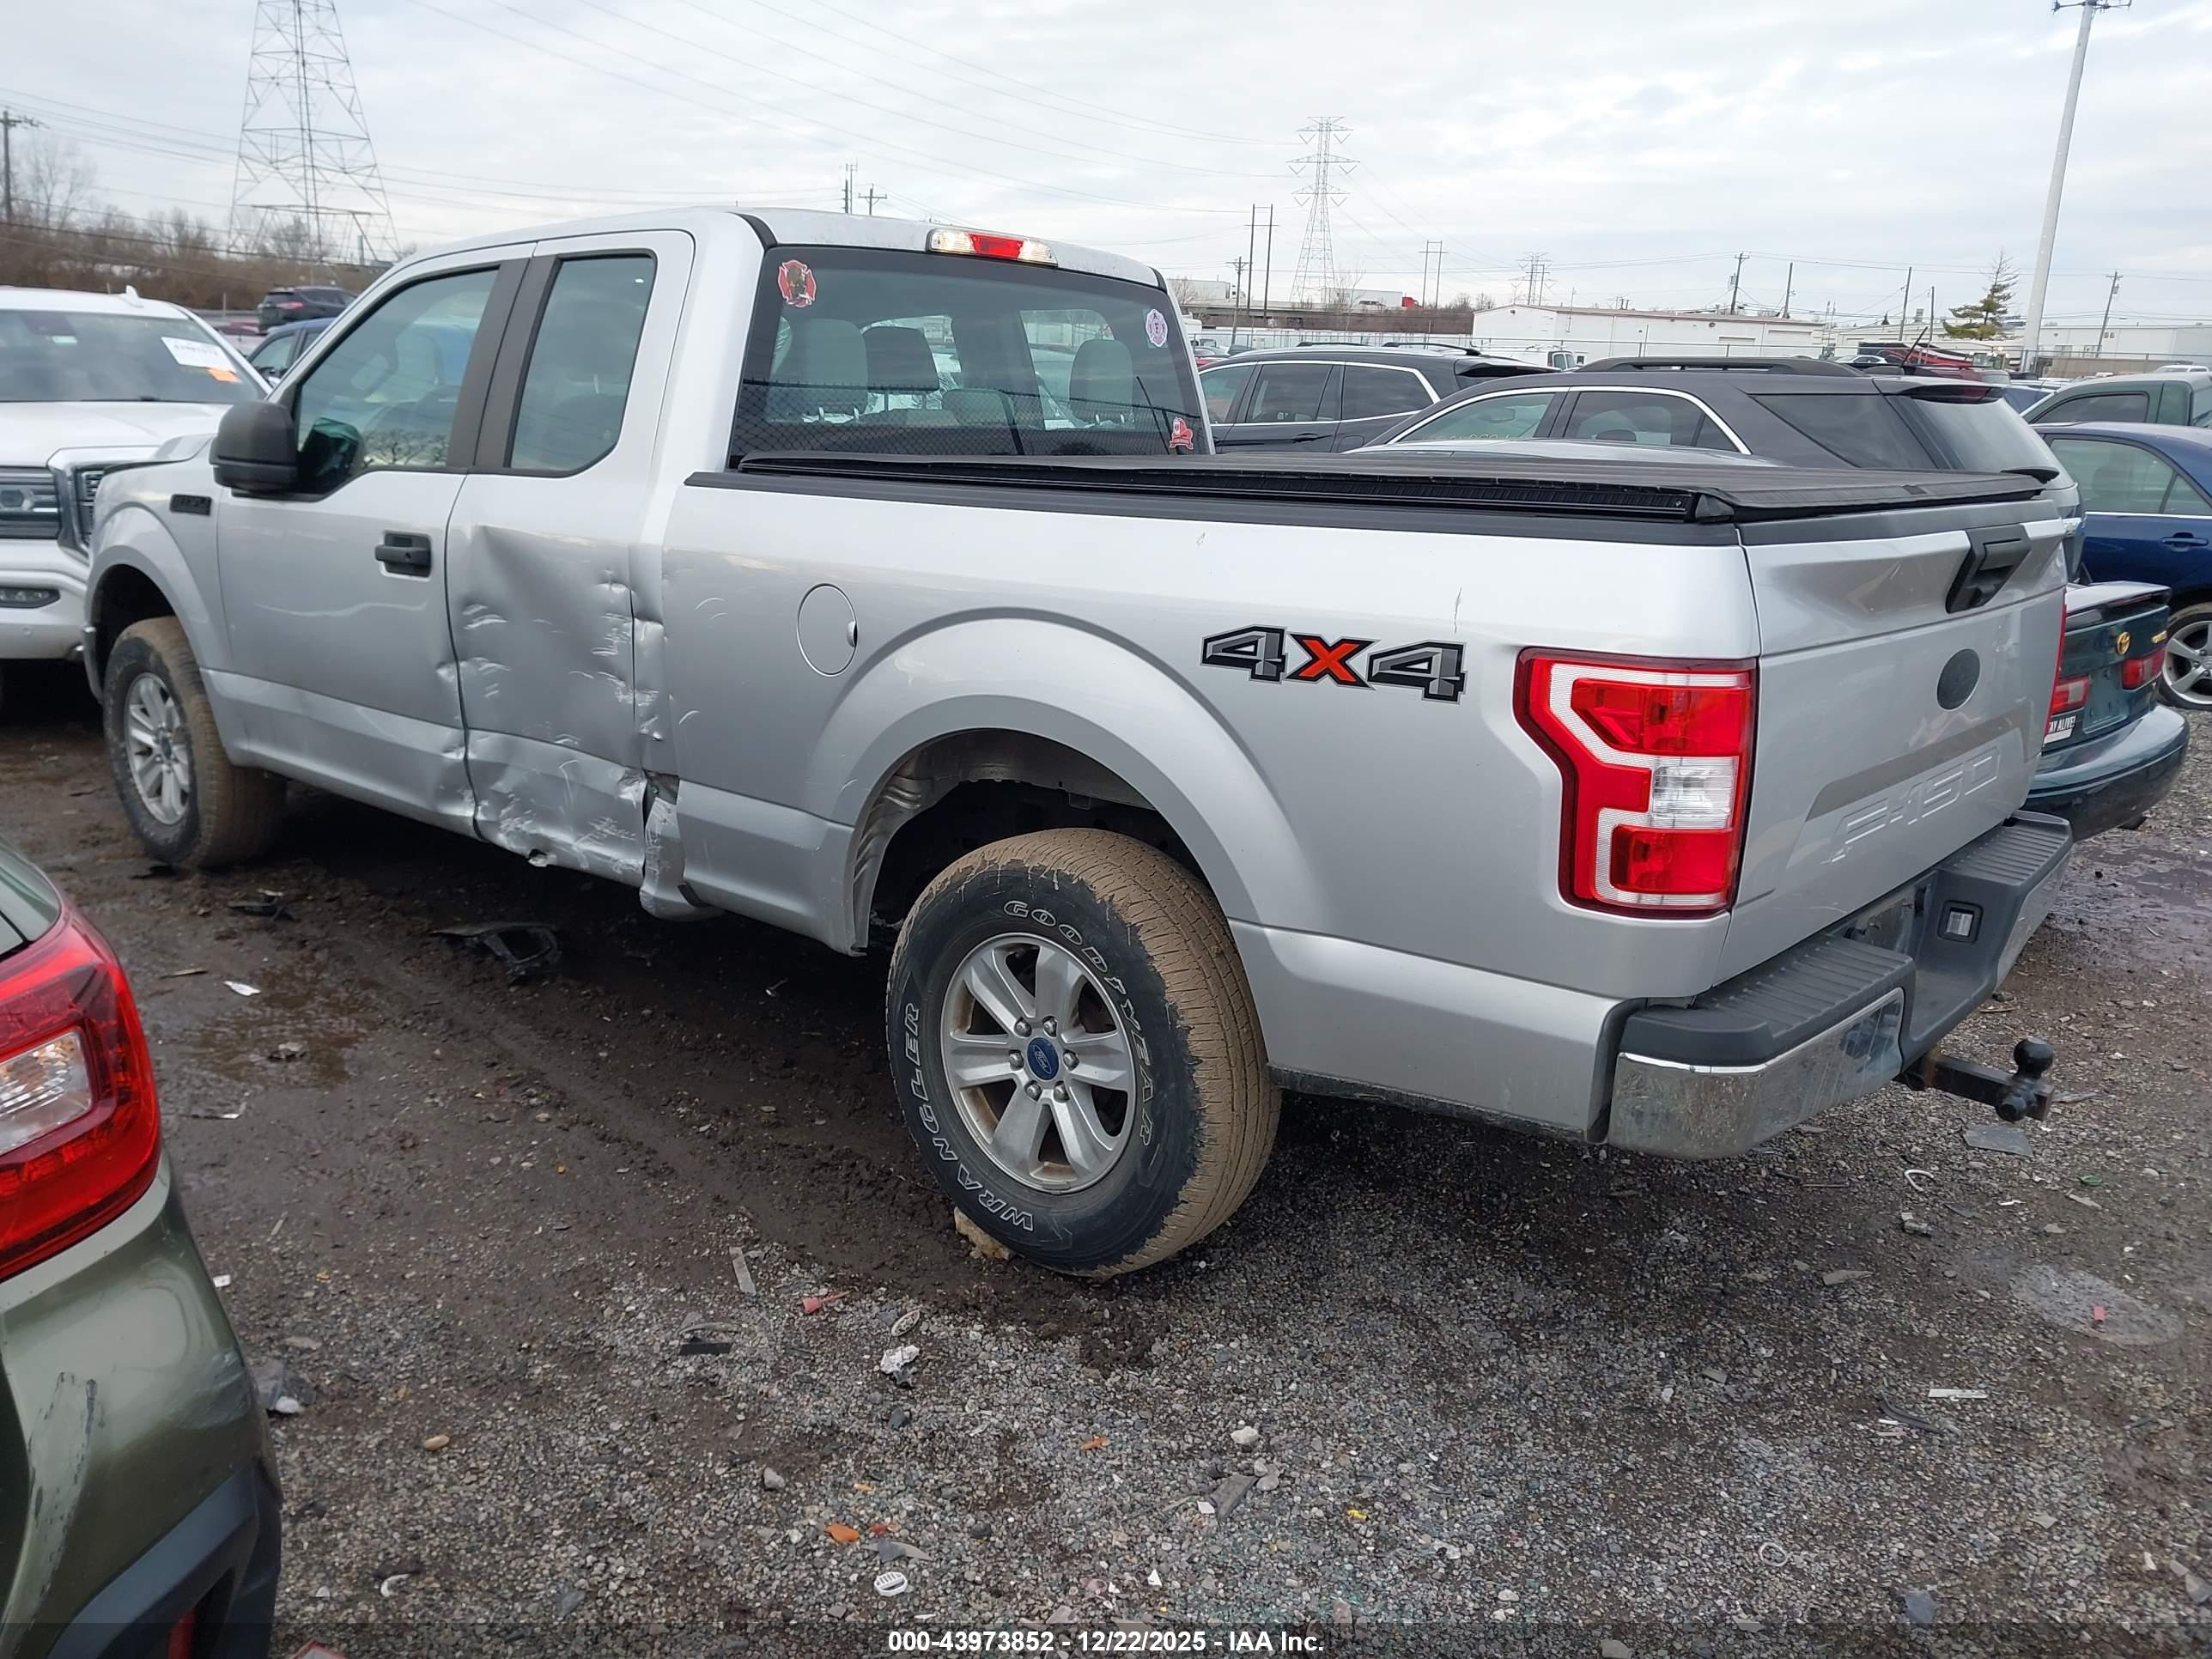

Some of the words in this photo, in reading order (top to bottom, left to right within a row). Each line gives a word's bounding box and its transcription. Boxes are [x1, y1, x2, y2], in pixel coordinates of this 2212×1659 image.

[1829, 745, 2001, 863] F-150
[904, 1002, 1034, 1231] WRANGLER
[1003, 900, 1155, 1146] GOODYEAR
